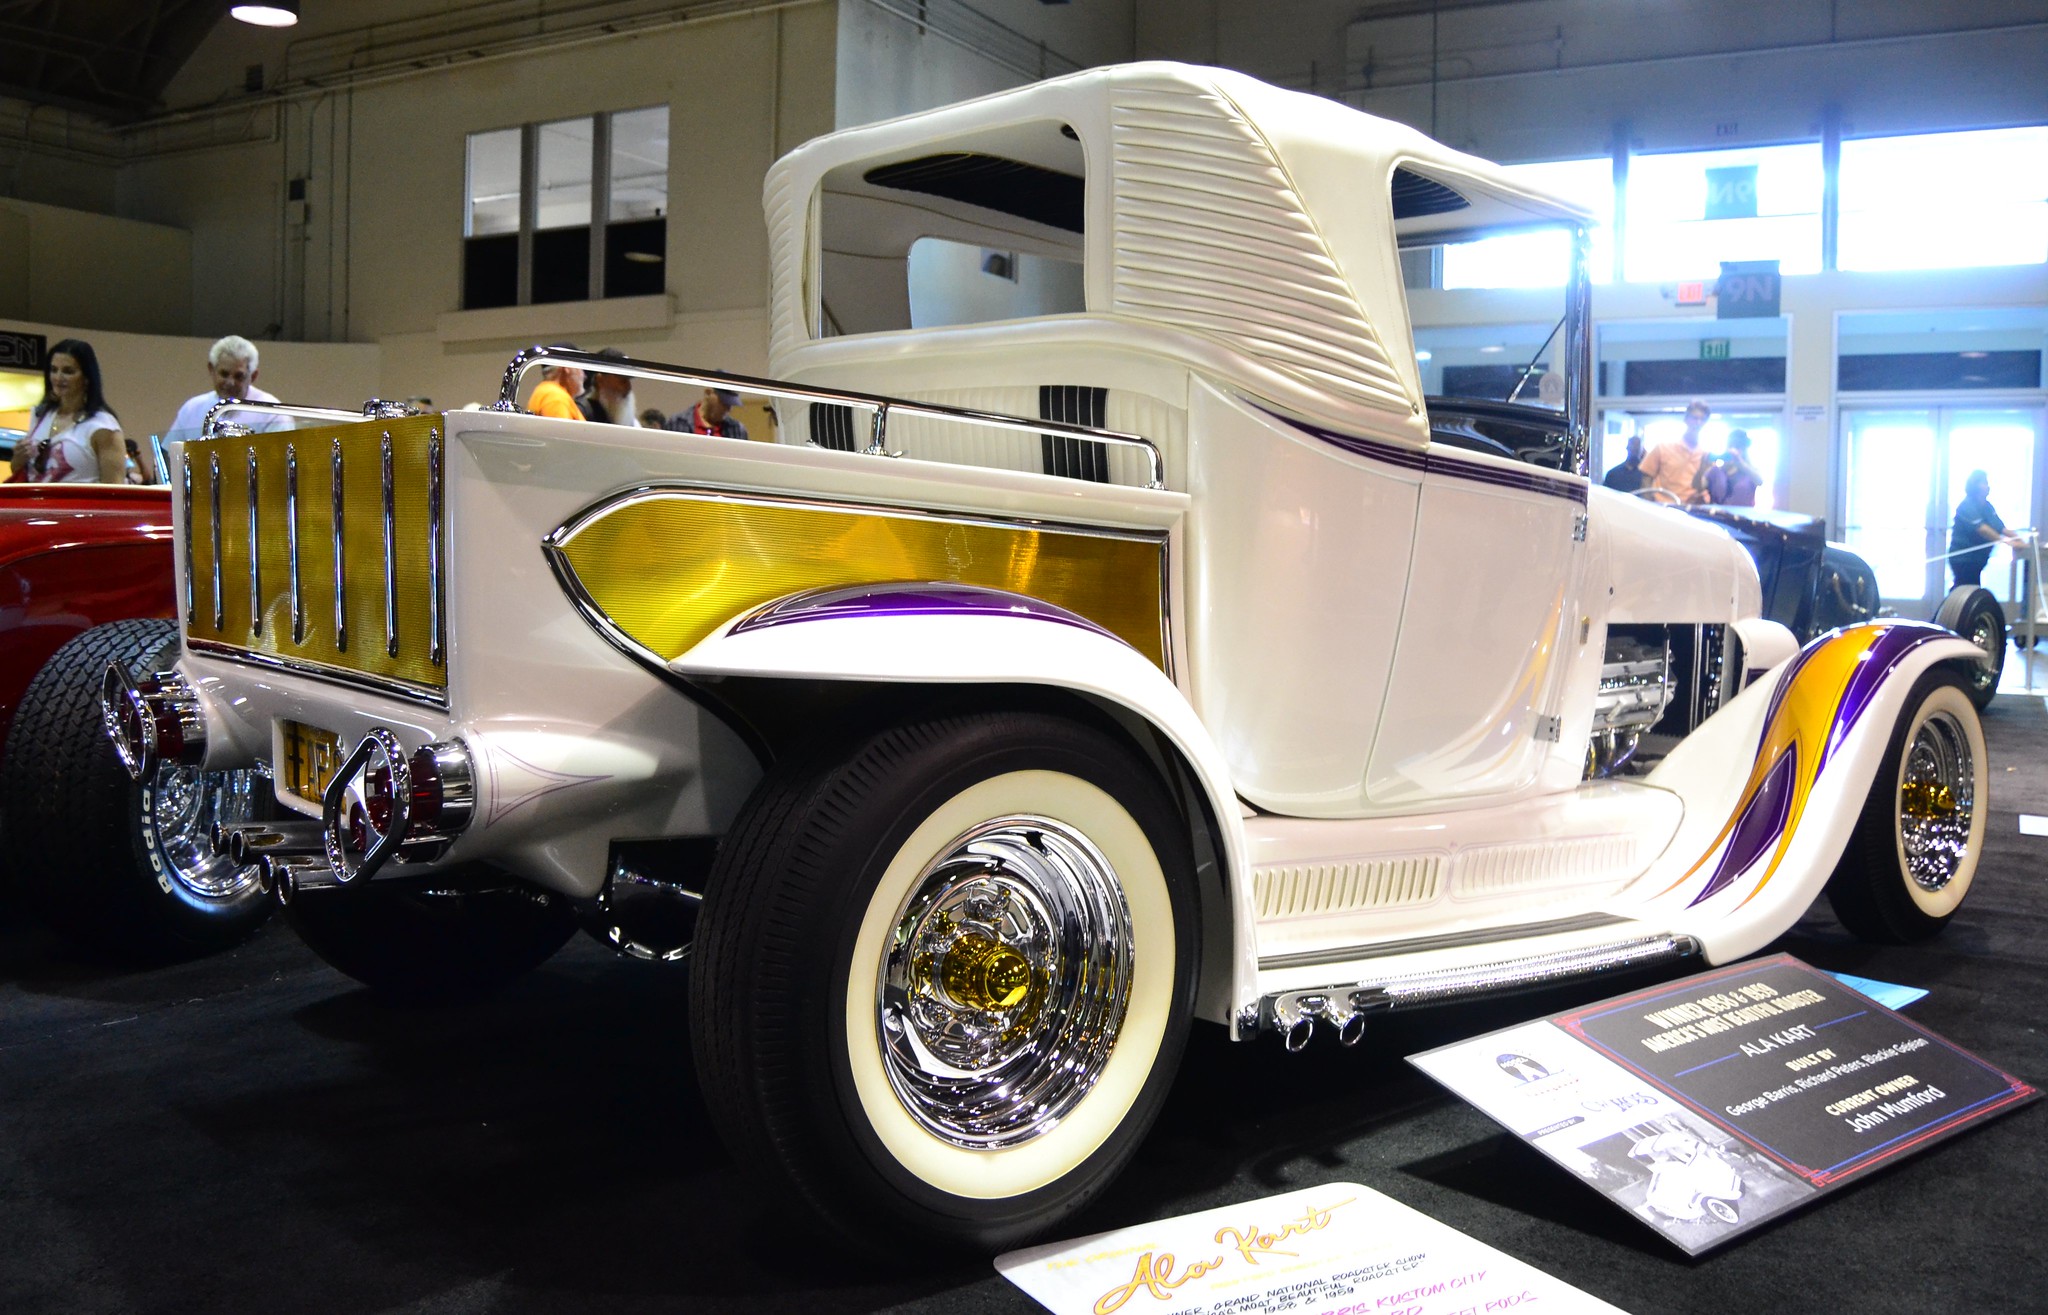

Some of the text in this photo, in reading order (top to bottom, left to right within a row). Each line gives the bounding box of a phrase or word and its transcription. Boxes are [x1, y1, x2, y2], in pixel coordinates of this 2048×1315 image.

[1641, 990, 1825, 1053] AMERICA'S MOST BEAUTIFUL ROADSTER
[1644, 983, 1778, 1029] WINNER 1958 & 1959
[1740, 1024, 1815, 1057] ALA KART
[1786, 1048, 1836, 1071] BUILT BY
[1726, 1097, 1768, 1115] George
[1763, 1085, 1802, 1101] Barris,
[1795, 1069, 1837, 1089] Richard
[1830, 1060, 1869, 1075] Peters,
[1861, 1049, 1898, 1064] Blackie
[1825, 1075, 1918, 1115] CURRENT OWNER
[1845, 1085, 1945, 1132] John Mumford
[1094, 1252, 1223, 1315] Ala
[1214, 1197, 1357, 1265] Kart
[1214, 1294, 1260, 1310] GRAND
[1267, 1279, 1326, 1297] NATIONAL
[1332, 1262, 1390, 1281] ROADSTER
[1396, 1253, 1425, 1265] SHOW
[1240, 1299, 1272, 1312] MOST
[1280, 1282, 1345, 1302] BEAUTIFUL
[1305, 1297, 1317, 1305] &
[1325, 1286, 1354, 1299] 1959
[1377, 1283, 1446, 1308] KUSTOM
[1451, 1270, 1486, 1288] CITY
[1485, 1291, 1538, 1312] RODS
